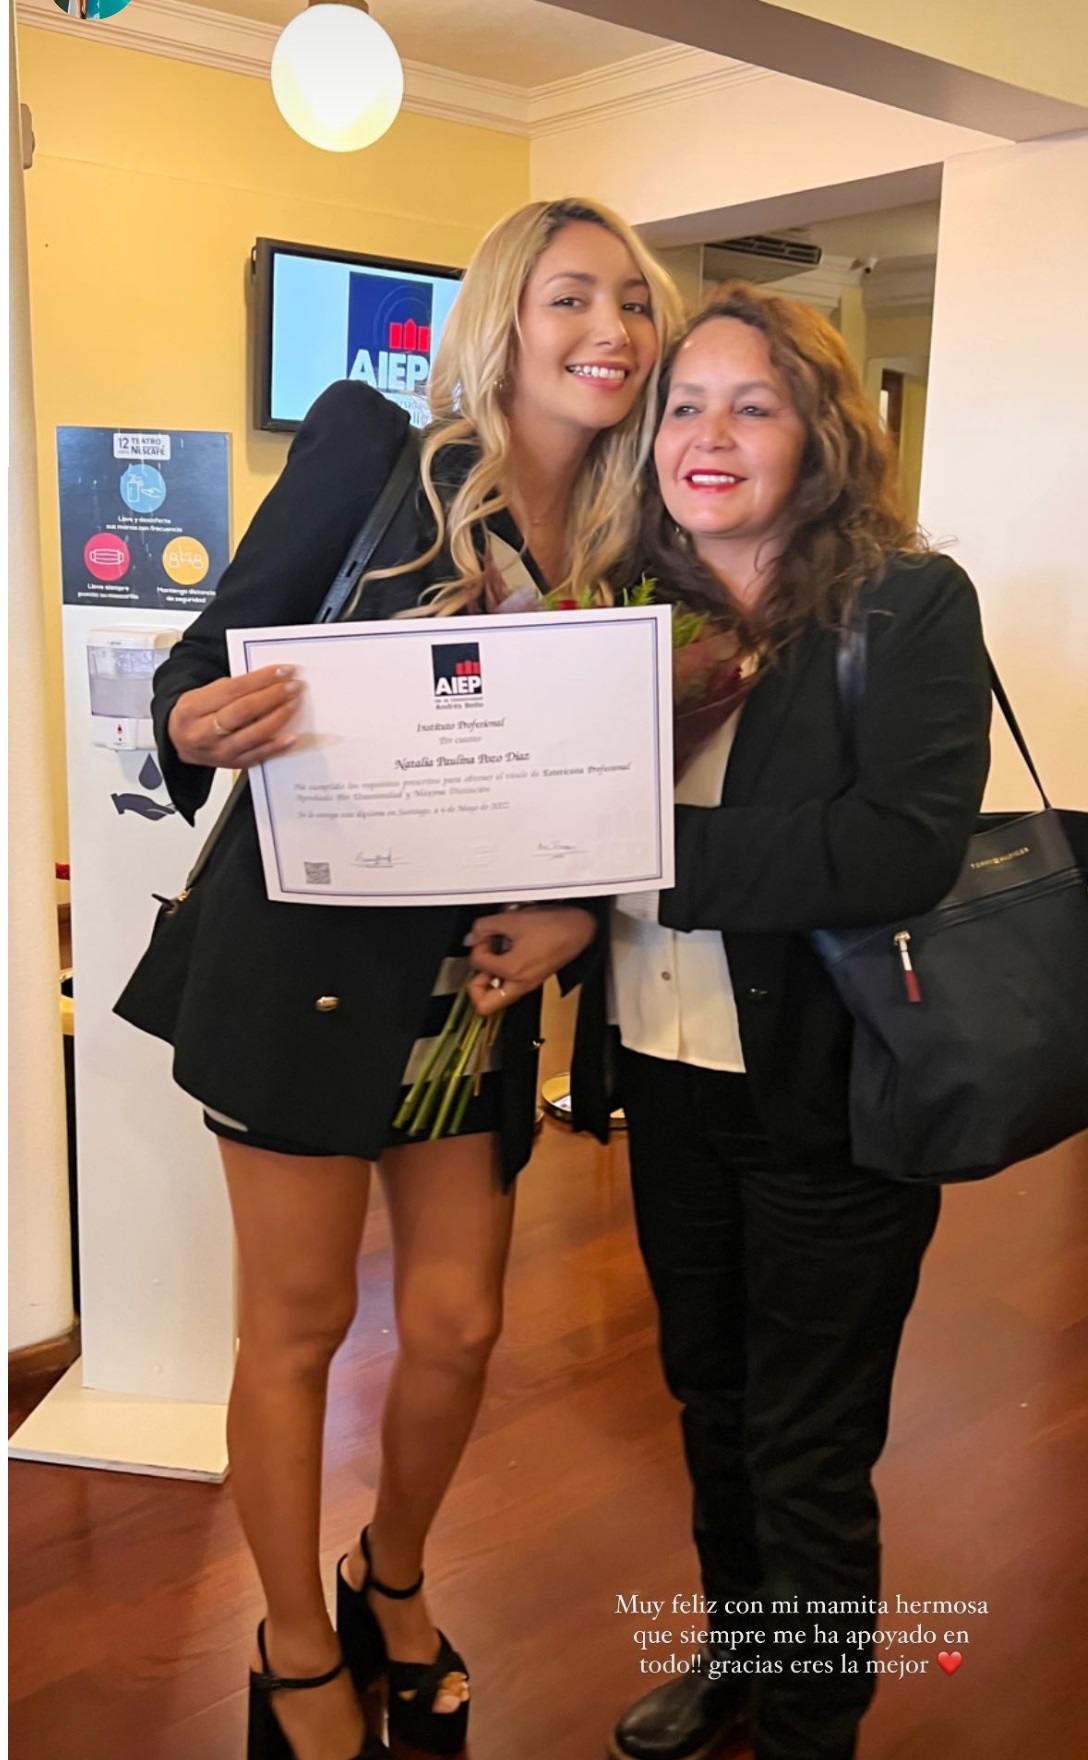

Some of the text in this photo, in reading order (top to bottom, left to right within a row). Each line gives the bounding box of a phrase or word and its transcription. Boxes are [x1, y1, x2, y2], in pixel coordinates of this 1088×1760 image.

[349, 349, 429, 391] AIEP
[118, 437, 162, 449] 12 TEATRO
[435, 676, 482, 695] AIEP
[416, 717, 506, 733] Instituto Profesional
[394, 757, 434, 771] Natalia
[436, 754, 475, 767] Paulina
[478, 753, 503, 765] Pozo
